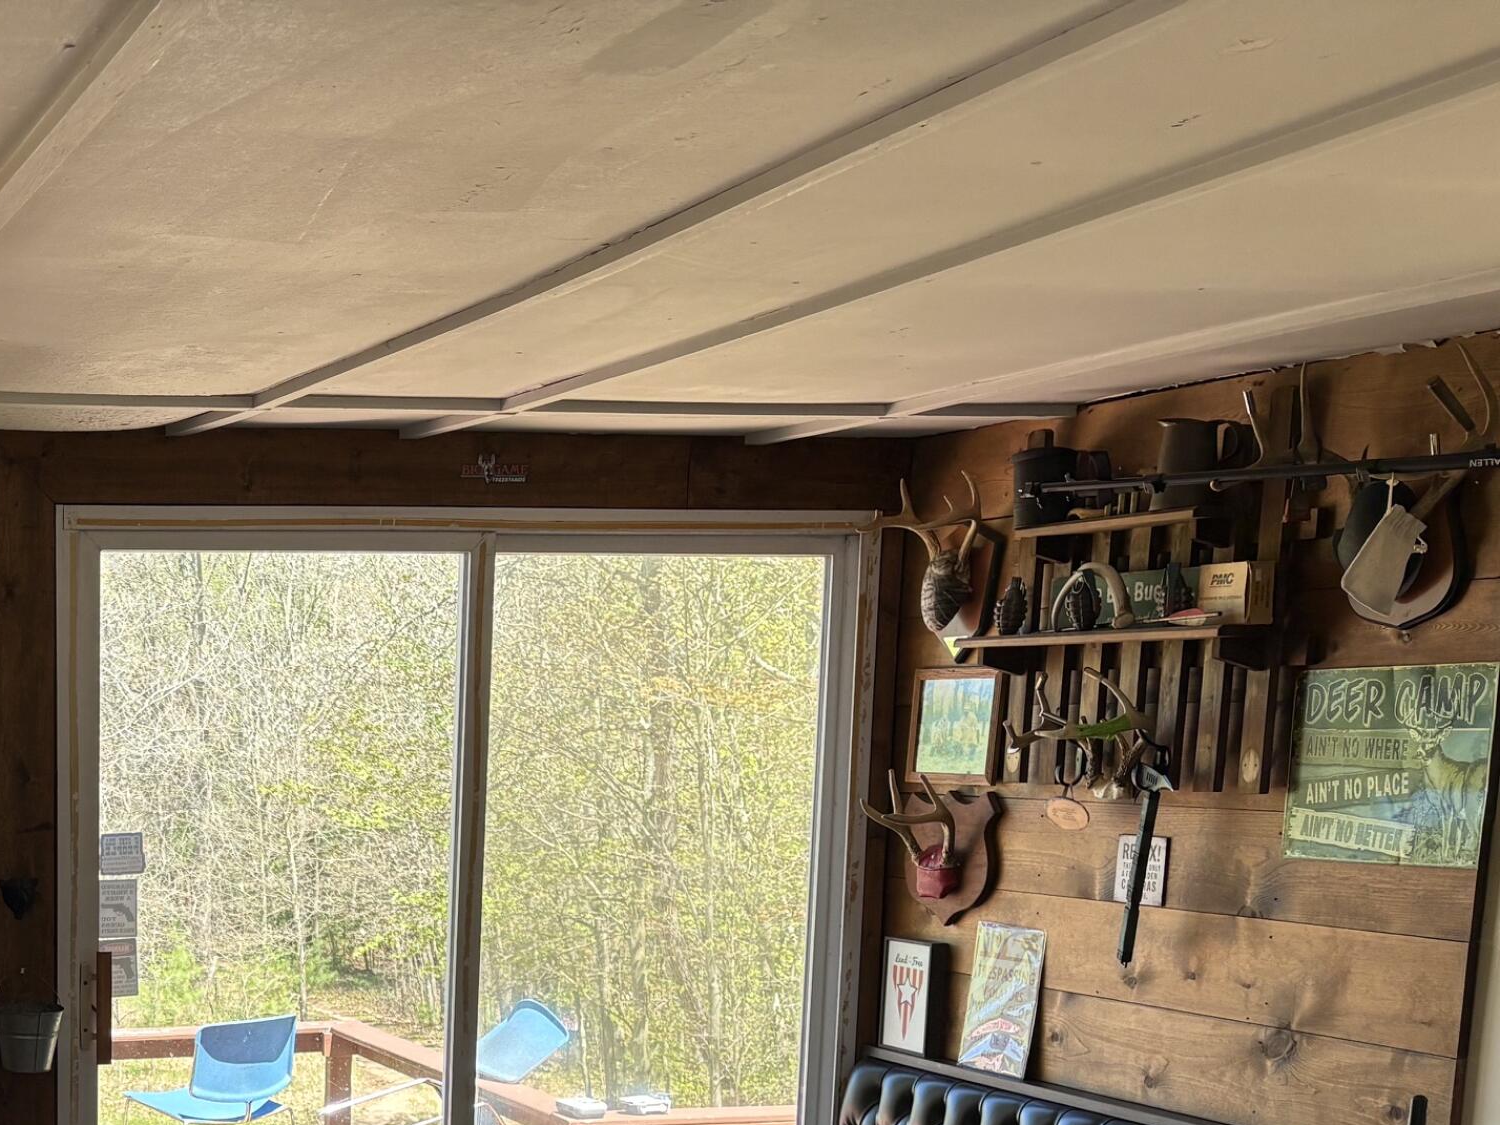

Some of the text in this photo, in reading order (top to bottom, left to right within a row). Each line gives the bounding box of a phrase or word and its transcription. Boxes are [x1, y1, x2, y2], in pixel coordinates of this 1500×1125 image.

[1209, 572, 1235, 587] PMC
[1305, 671, 1488, 728] DEER CAMP
[1306, 735, 1409, 761] AIN'T NO WHERE
[1306, 772, 1410, 804] AIN'T NO PLACE
[1300, 814, 1334, 840] AIN'T
[1335, 819, 1355, 843] NO
